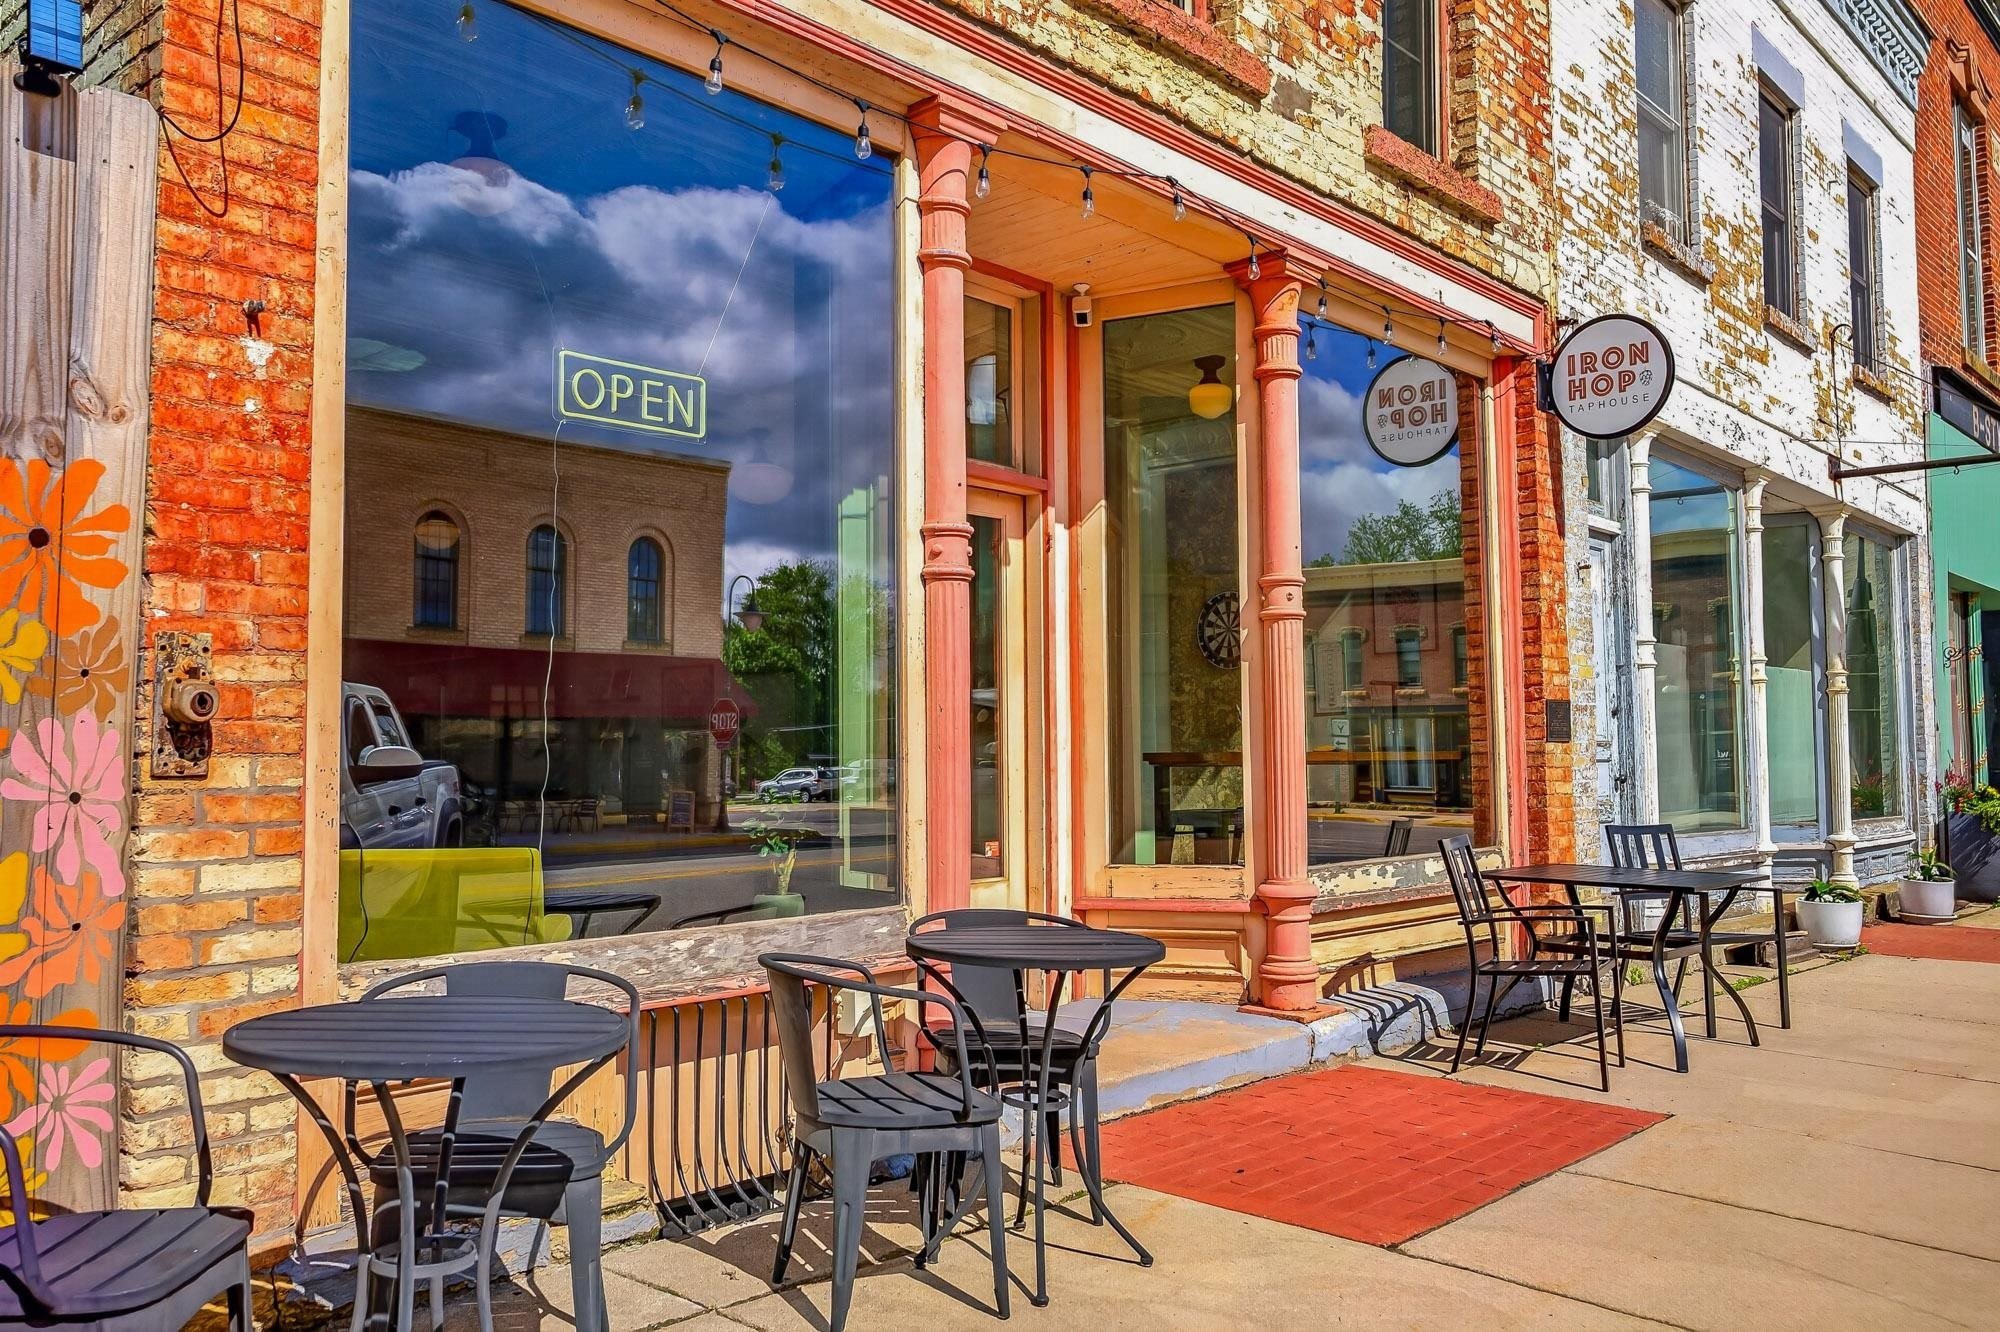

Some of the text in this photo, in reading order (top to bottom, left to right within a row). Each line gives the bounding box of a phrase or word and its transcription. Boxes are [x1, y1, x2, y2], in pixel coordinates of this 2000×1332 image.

[1567, 341, 1649, 377] IRON
[571, 368, 694, 428] OPEN
[1568, 369, 1636, 401] HOP
[1568, 393, 1650, 414] TAPHOUSE
[1972, 404, 2000, 451] B-ST
